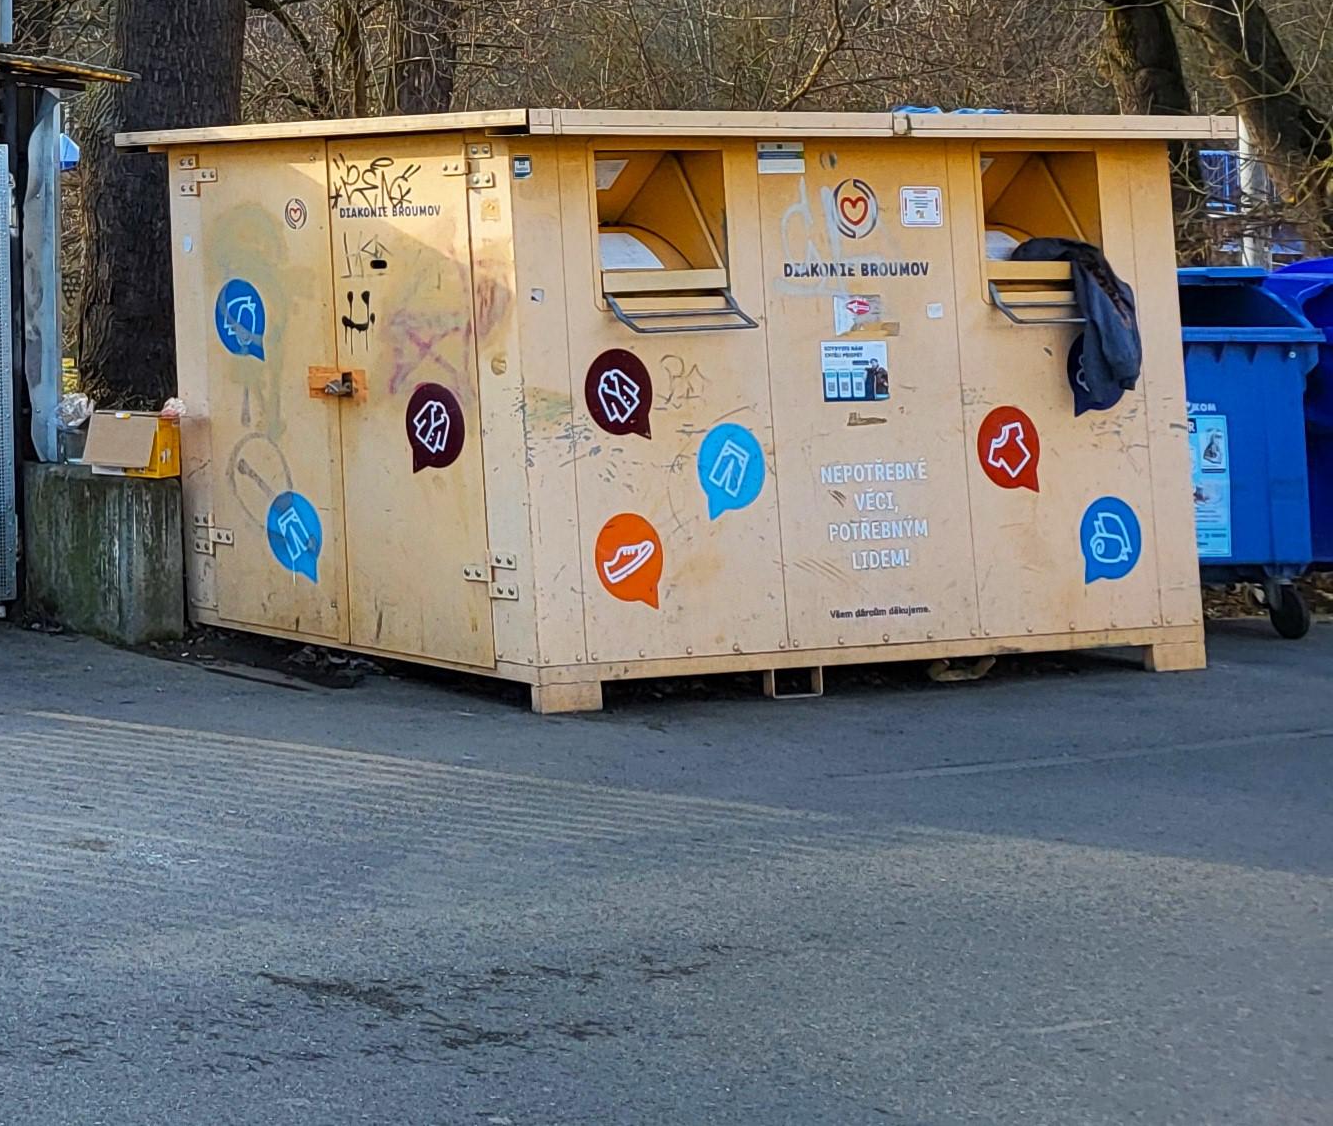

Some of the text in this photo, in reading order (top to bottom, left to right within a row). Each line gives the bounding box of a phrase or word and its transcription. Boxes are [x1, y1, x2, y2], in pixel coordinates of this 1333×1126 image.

[340, 205, 441, 218] DIAKONIE BROUMOV
[783, 262, 929, 277] DIAKONIE BROUMOV
[820, 458, 928, 484] NEPOTŘEBNÉ
[854, 488, 899, 513] VĚCI,
[829, 516, 928, 541] POTŘEBNÝM
[852, 548, 910, 570] LIDEM!
[830, 609, 853, 619] Všem
[855, 607, 887, 618] dárcům
